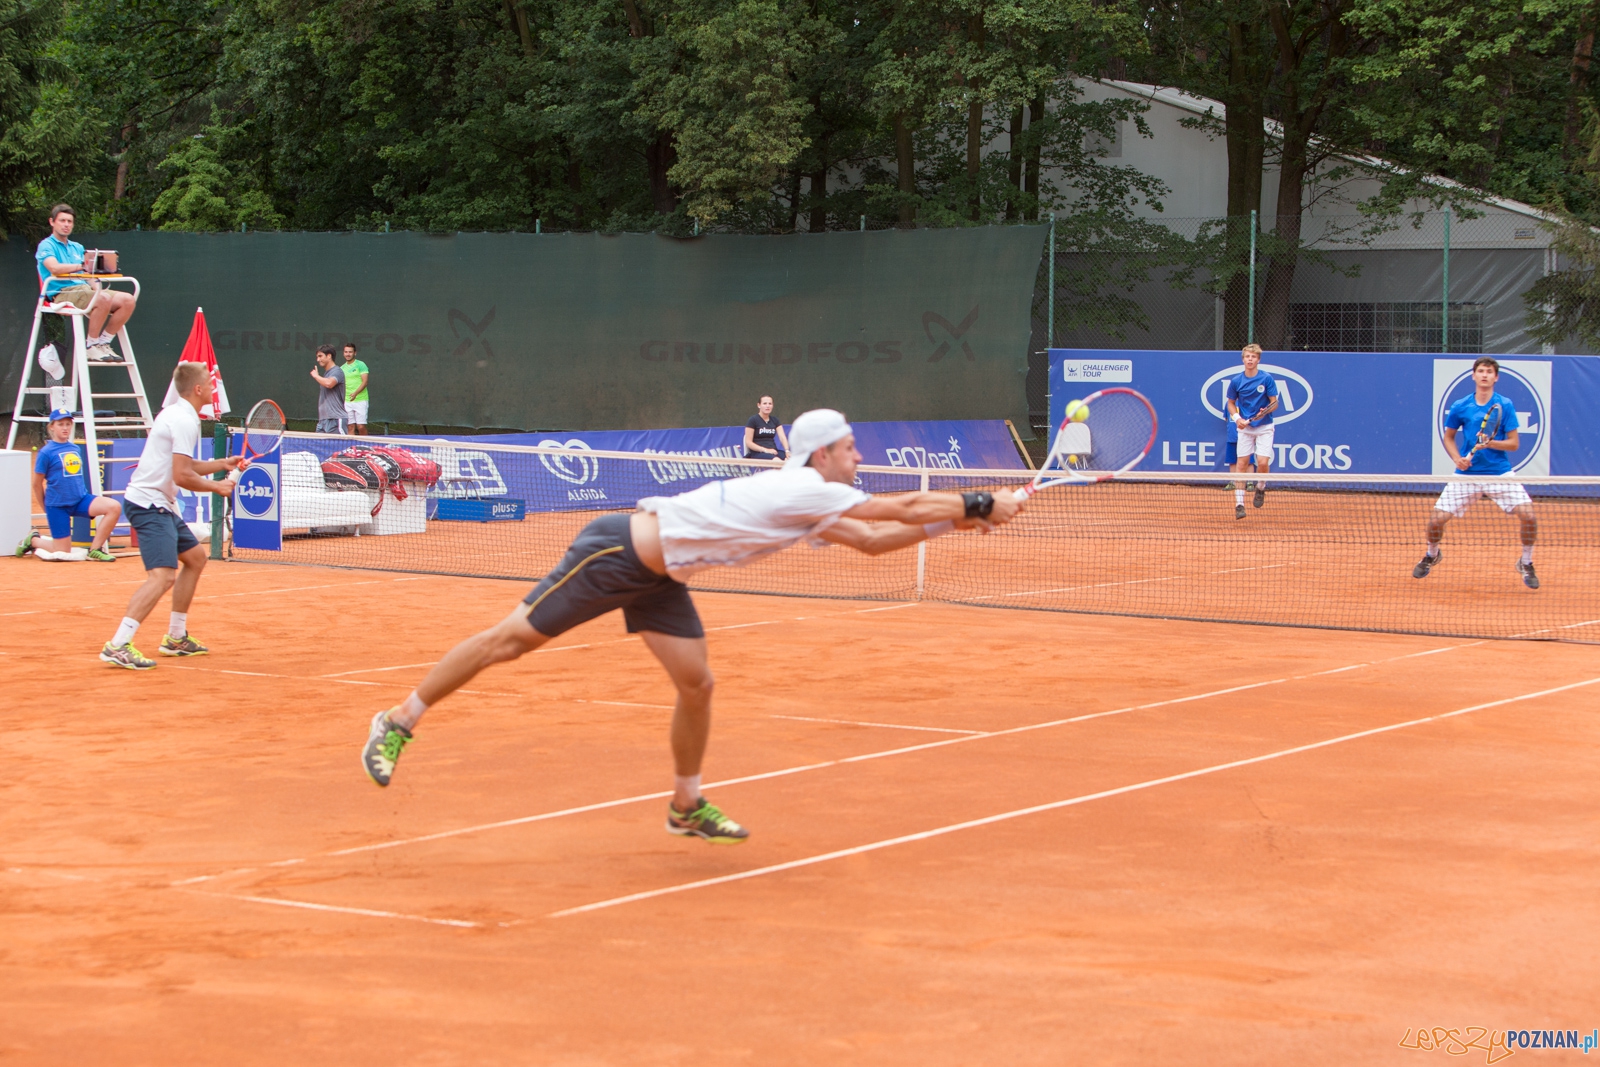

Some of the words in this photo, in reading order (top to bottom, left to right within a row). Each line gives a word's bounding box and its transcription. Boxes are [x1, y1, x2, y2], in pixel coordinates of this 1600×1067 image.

[639, 339, 903, 365] GRUNDFOS
[1162, 441, 1216, 466] LEE
[1224, 443, 1352, 471] TORS
[567, 488, 608, 501] ALGIDA
[492, 502, 511, 516] plus
